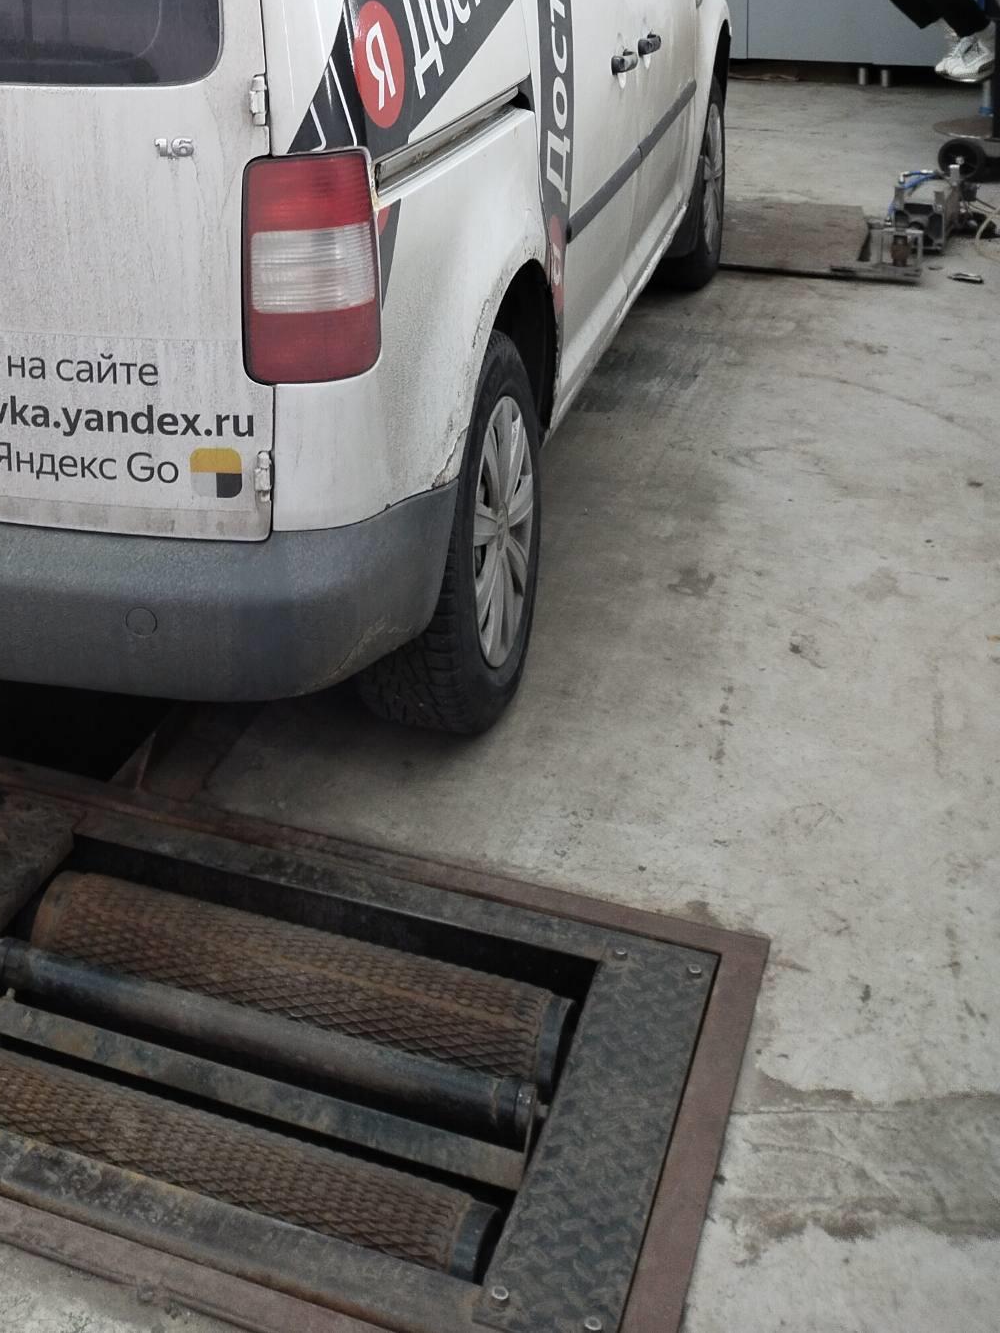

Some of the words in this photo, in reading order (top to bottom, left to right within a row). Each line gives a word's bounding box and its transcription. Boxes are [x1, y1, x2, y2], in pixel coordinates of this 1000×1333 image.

[365, 22, 397, 112] Я
[6, 354, 46, 380] на
[55, 353, 159, 387] сайте
[126, 451, 180, 484] Go
